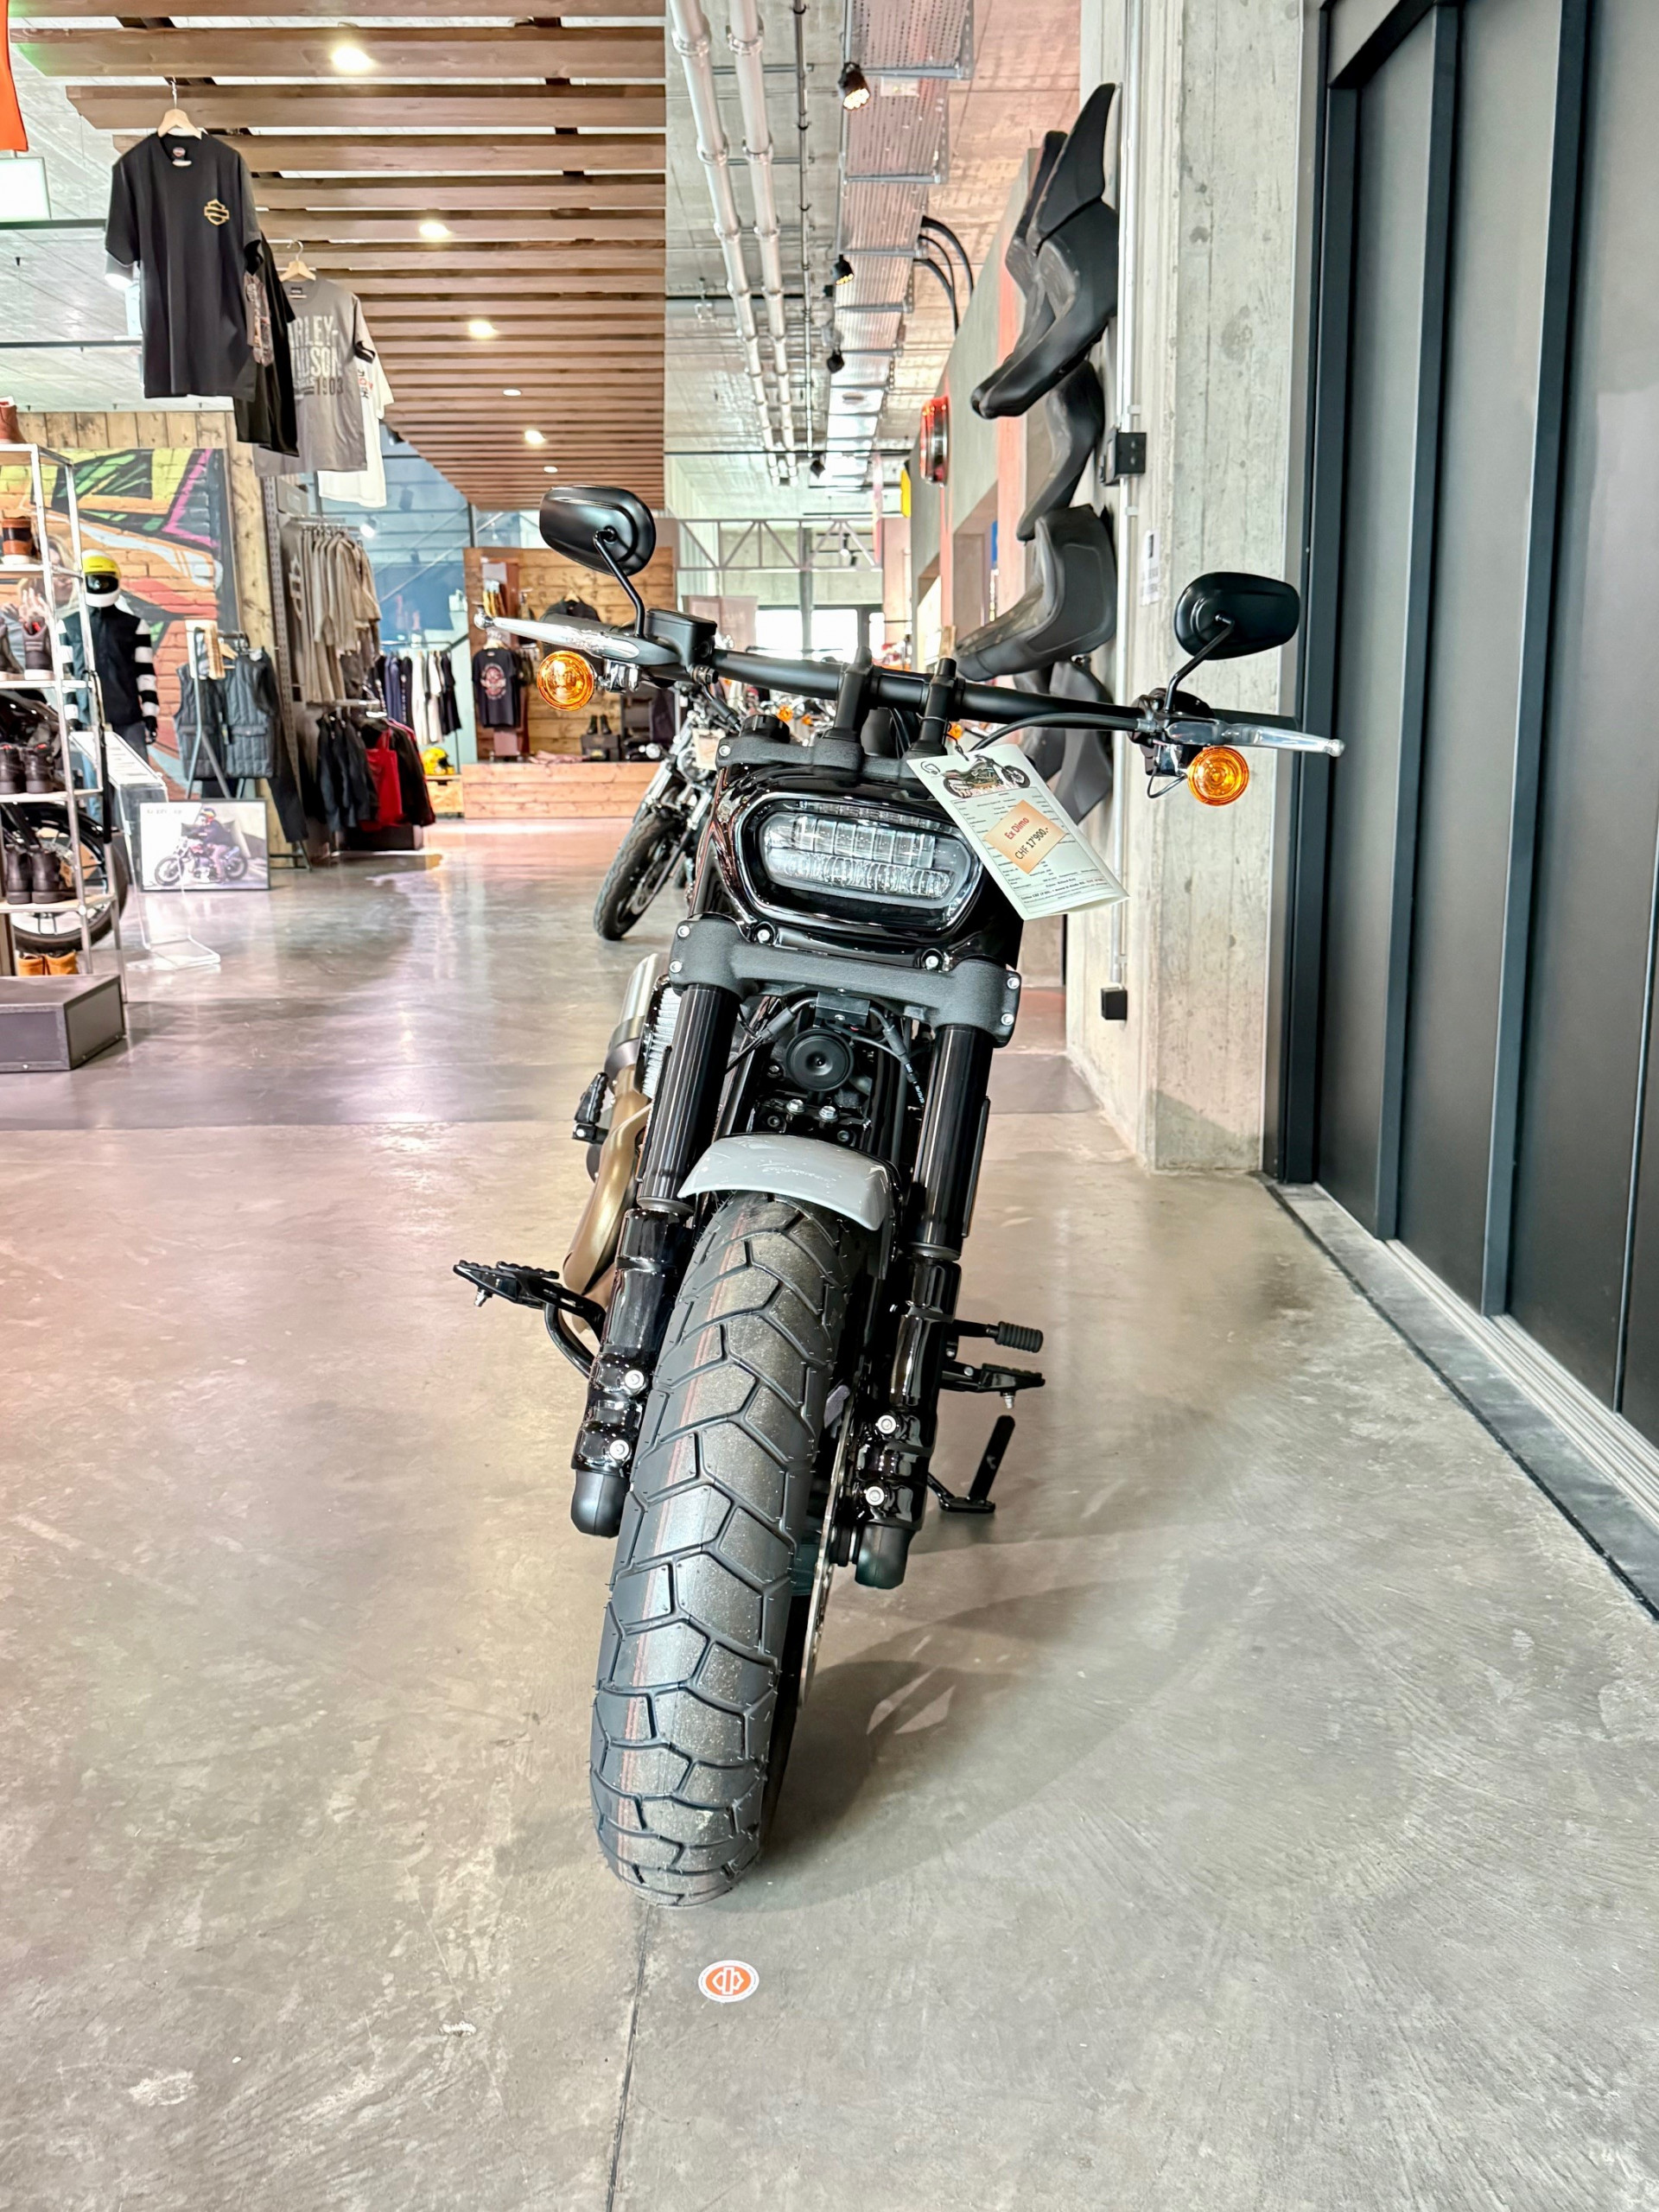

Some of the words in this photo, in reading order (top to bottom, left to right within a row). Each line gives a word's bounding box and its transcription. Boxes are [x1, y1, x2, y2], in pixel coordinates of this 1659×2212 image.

[288, 315, 339, 347] RLEY-
[316, 377, 343, 396] 1903
[1014, 845, 1029, 860] CHF
